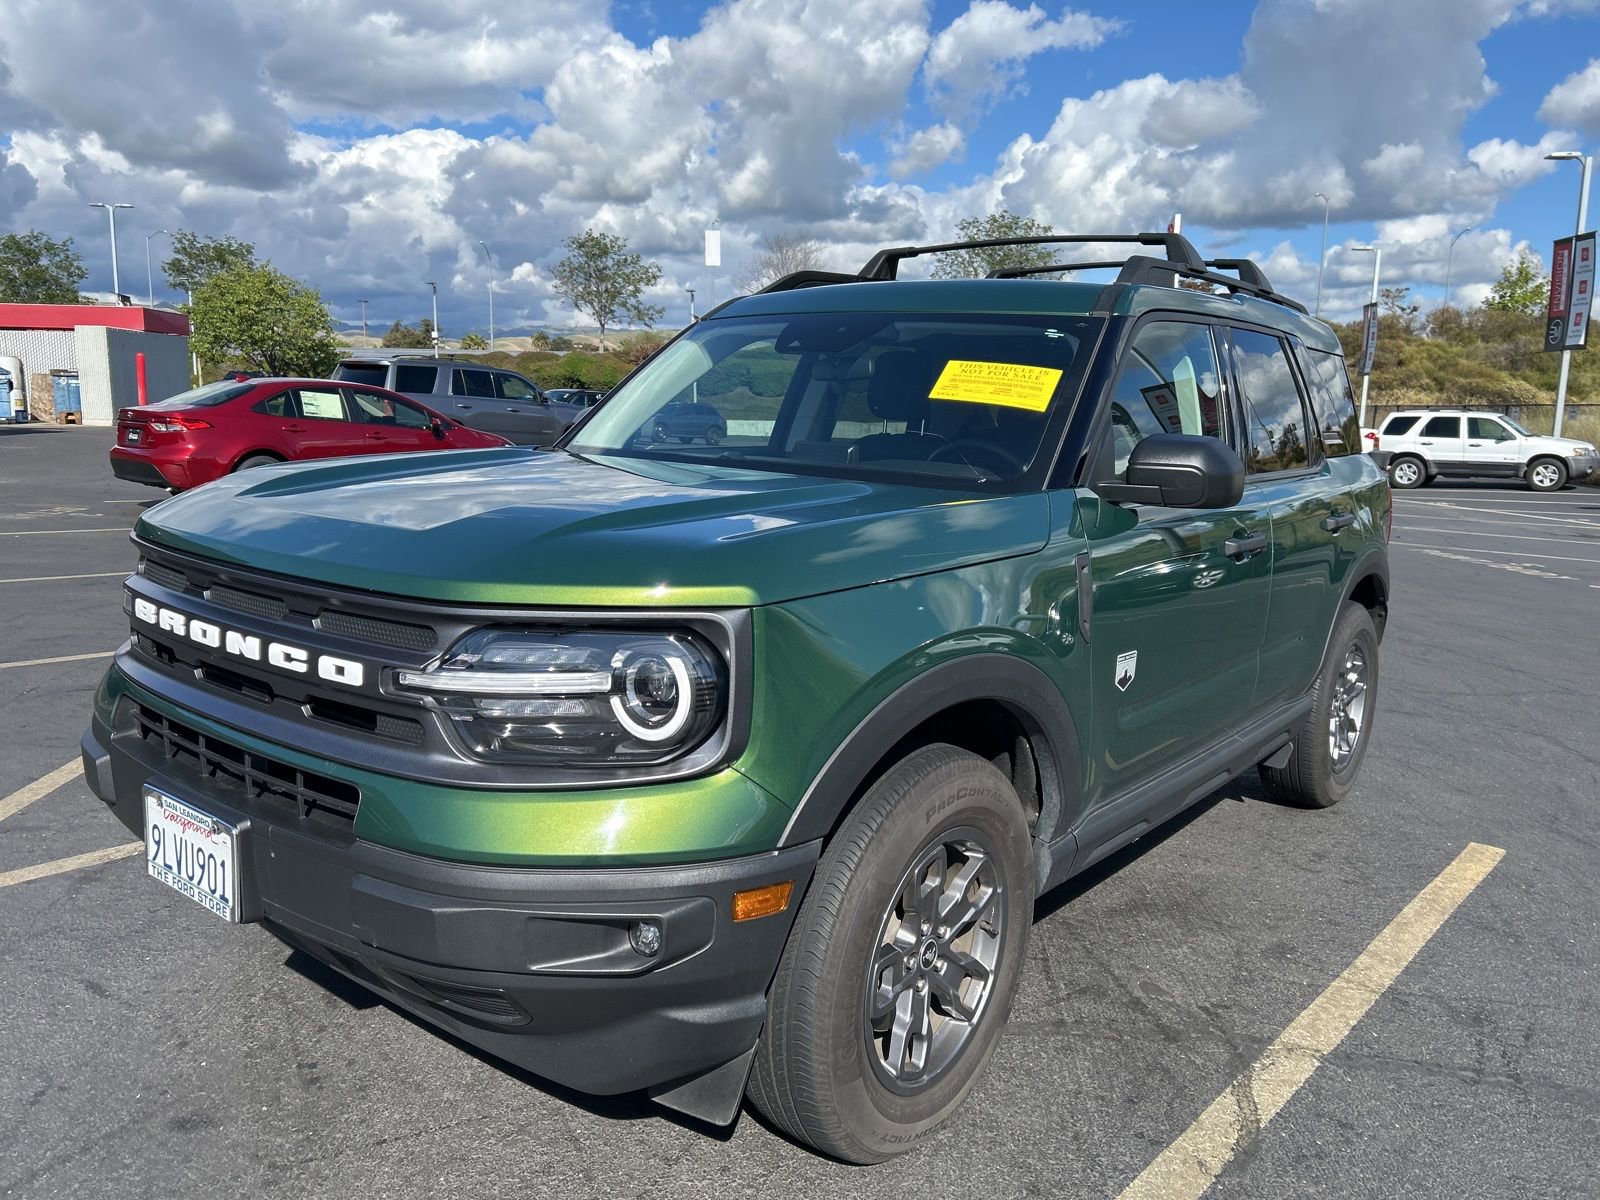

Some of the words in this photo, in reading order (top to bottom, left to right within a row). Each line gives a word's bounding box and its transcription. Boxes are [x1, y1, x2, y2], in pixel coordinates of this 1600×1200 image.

[1553, 251, 1563, 311] ENVISION
[987, 364, 1035, 374] VEHICLE
[1013, 372, 1042, 380] SALE
[134, 597, 364, 687] BRONCO
[164, 799, 178, 812] SAN
[178, 806, 210, 828] LEANDRO
[152, 823, 229, 904] 9LVU901
[151, 864, 170, 883] THE
[172, 876, 195, 898] FORD
[198, 892, 228, 918] STORE
